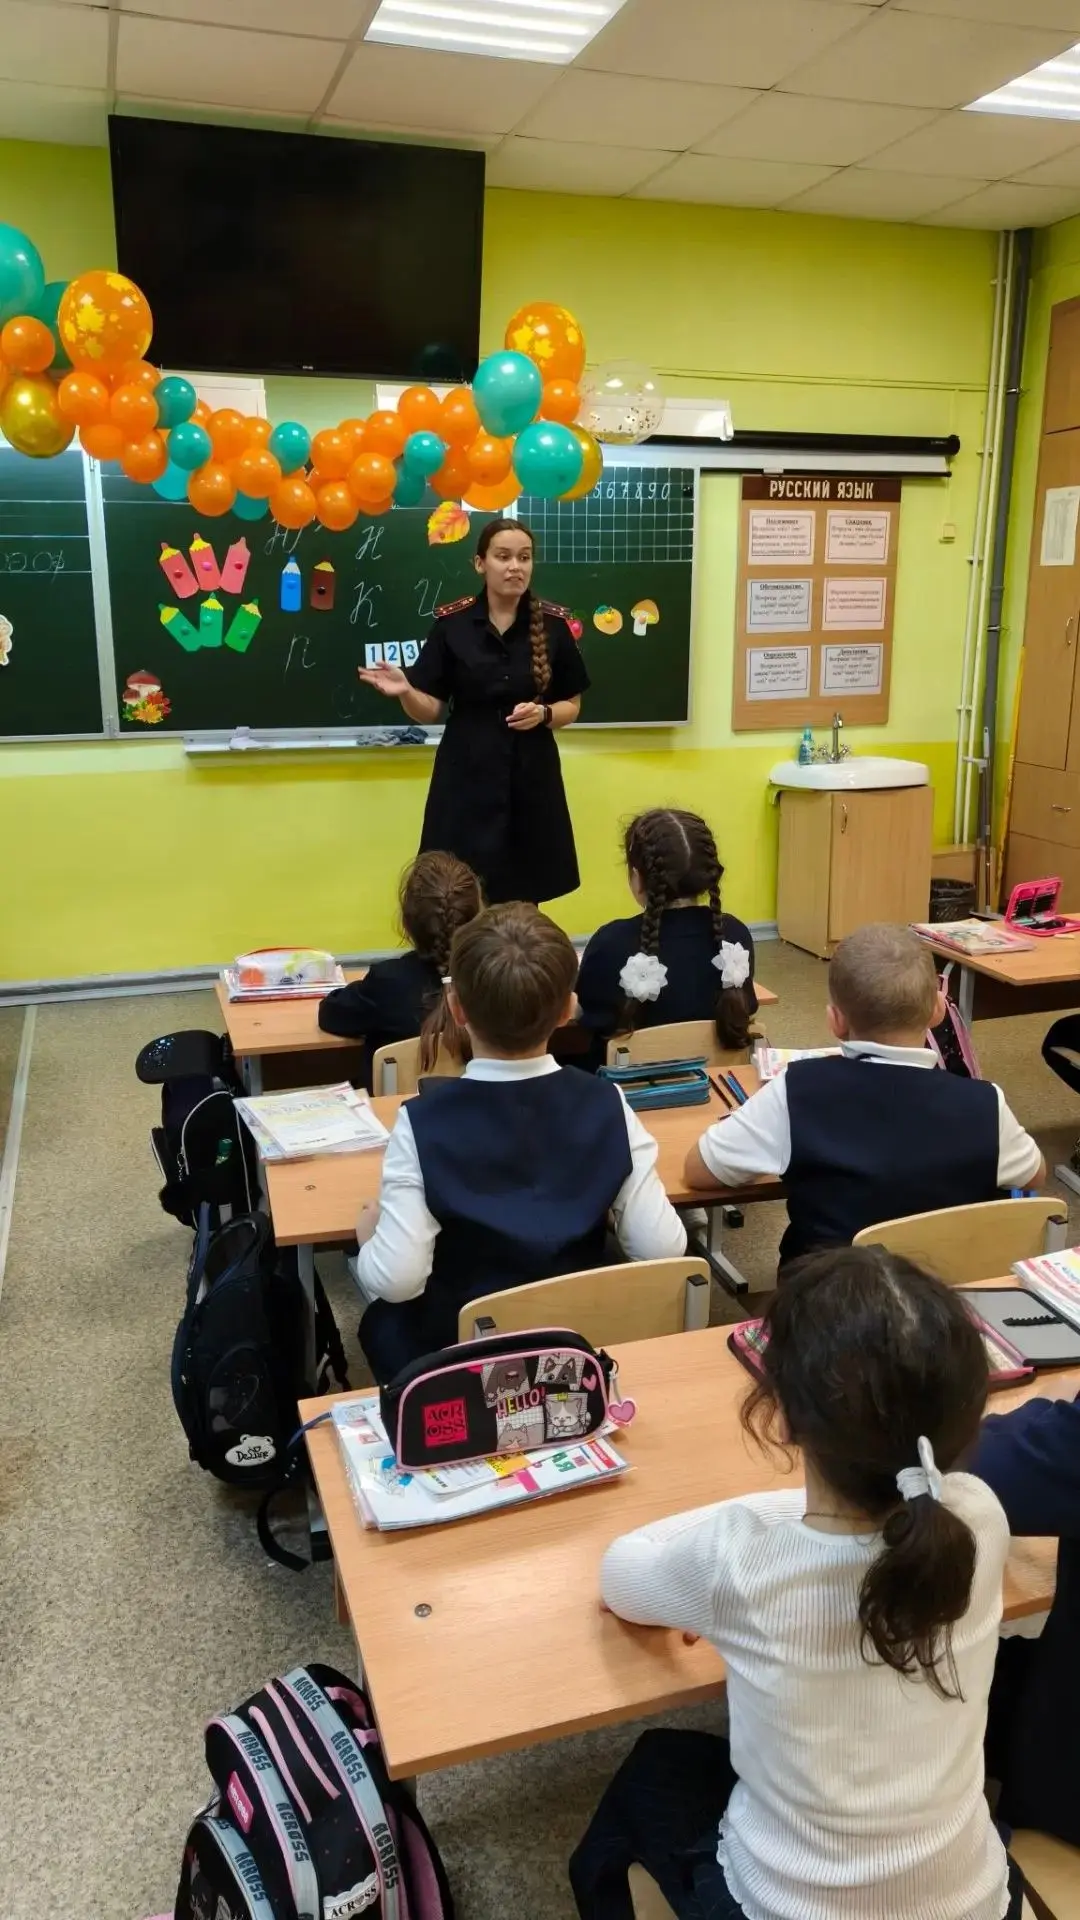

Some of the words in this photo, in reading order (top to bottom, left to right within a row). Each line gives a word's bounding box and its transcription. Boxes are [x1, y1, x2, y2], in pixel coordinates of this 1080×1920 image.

[770, 480, 830, 498] РУССКИЙ
[837, 481, 874, 499] ЯЗЫК
[292, 1676, 326, 1712] ACROSS
[236, 1731, 272, 1771] ACROSS
[330, 1730, 367, 1785] ACROSS
[276, 1803, 309, 1863] ACROSS
[371, 1822, 399, 1890] ACROSS
[234, 1852, 268, 1902] ACROSS
